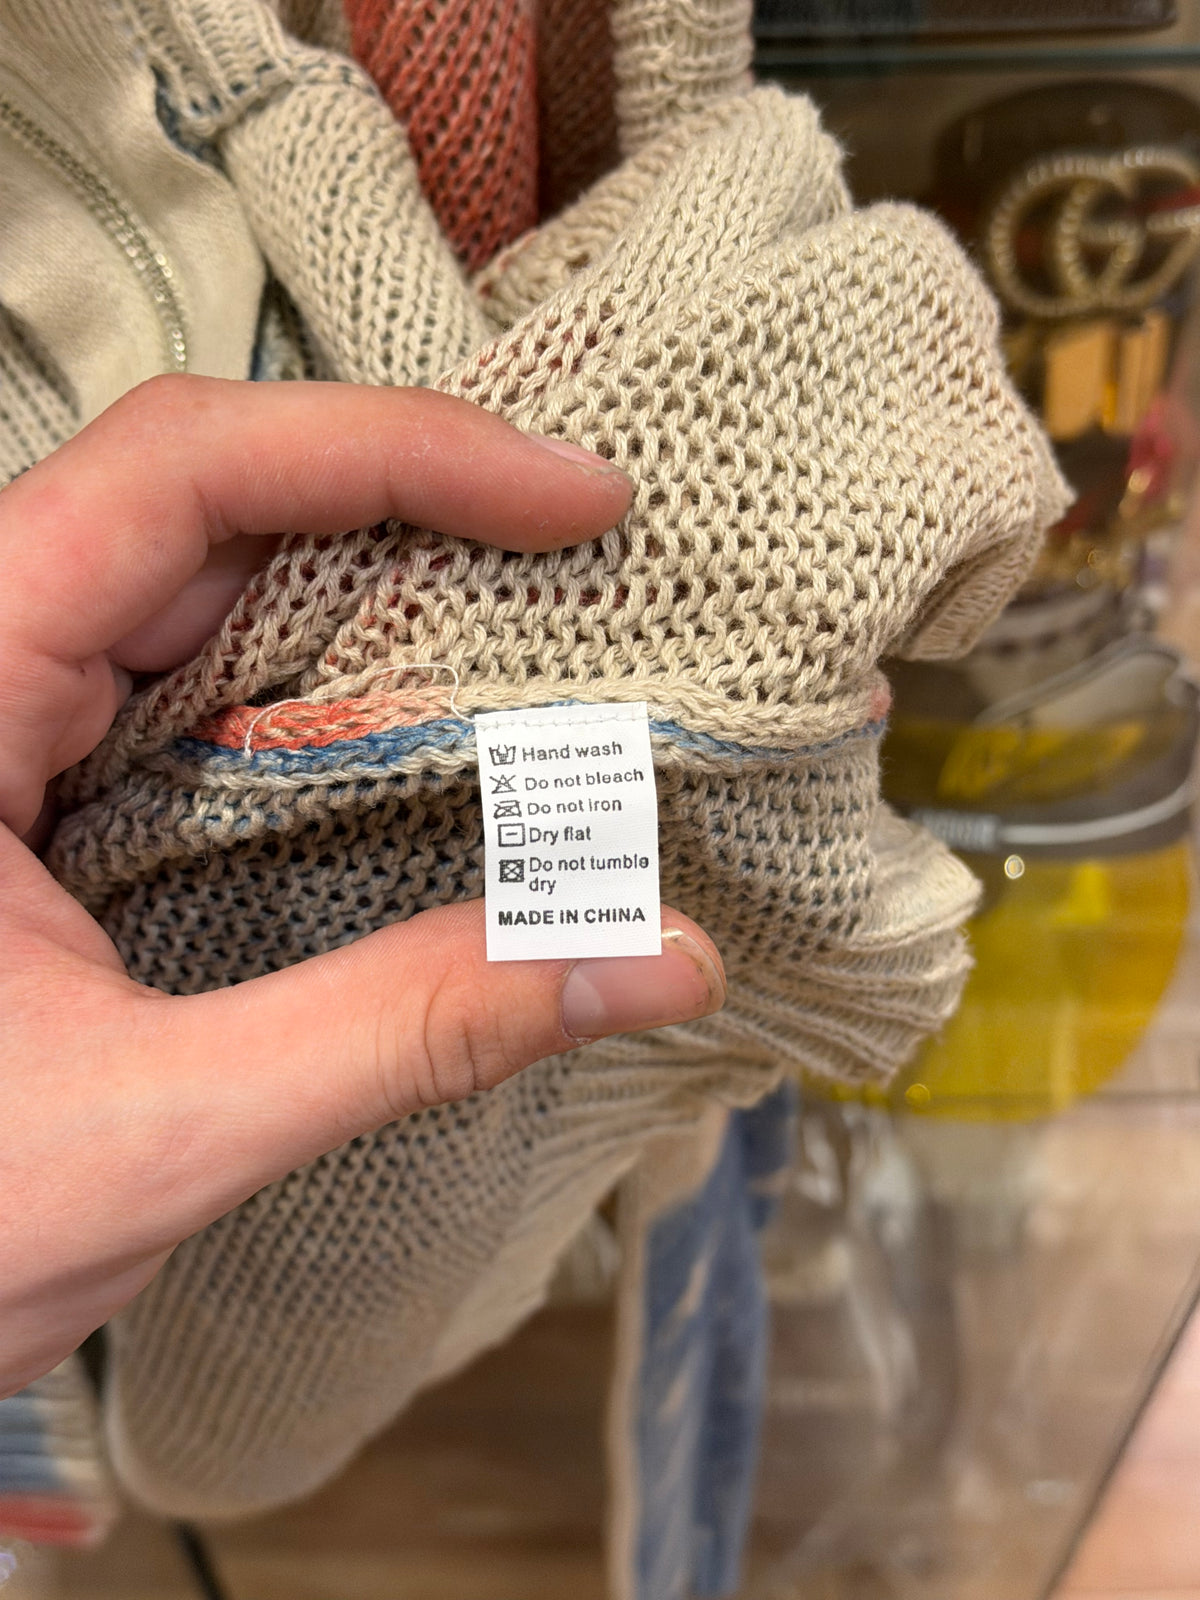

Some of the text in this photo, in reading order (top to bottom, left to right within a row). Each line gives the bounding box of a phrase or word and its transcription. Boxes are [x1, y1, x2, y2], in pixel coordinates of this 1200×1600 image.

[522, 741, 623, 762] Hand wash
[525, 769, 644, 791] Do not bleach
[528, 798, 622, 816] Do not iron
[529, 826, 591, 846] Dry flat
[529, 854, 649, 872] Do not tumble
[529, 877, 556, 895] dry
[498, 907, 646, 926] MADE IN CHINA
